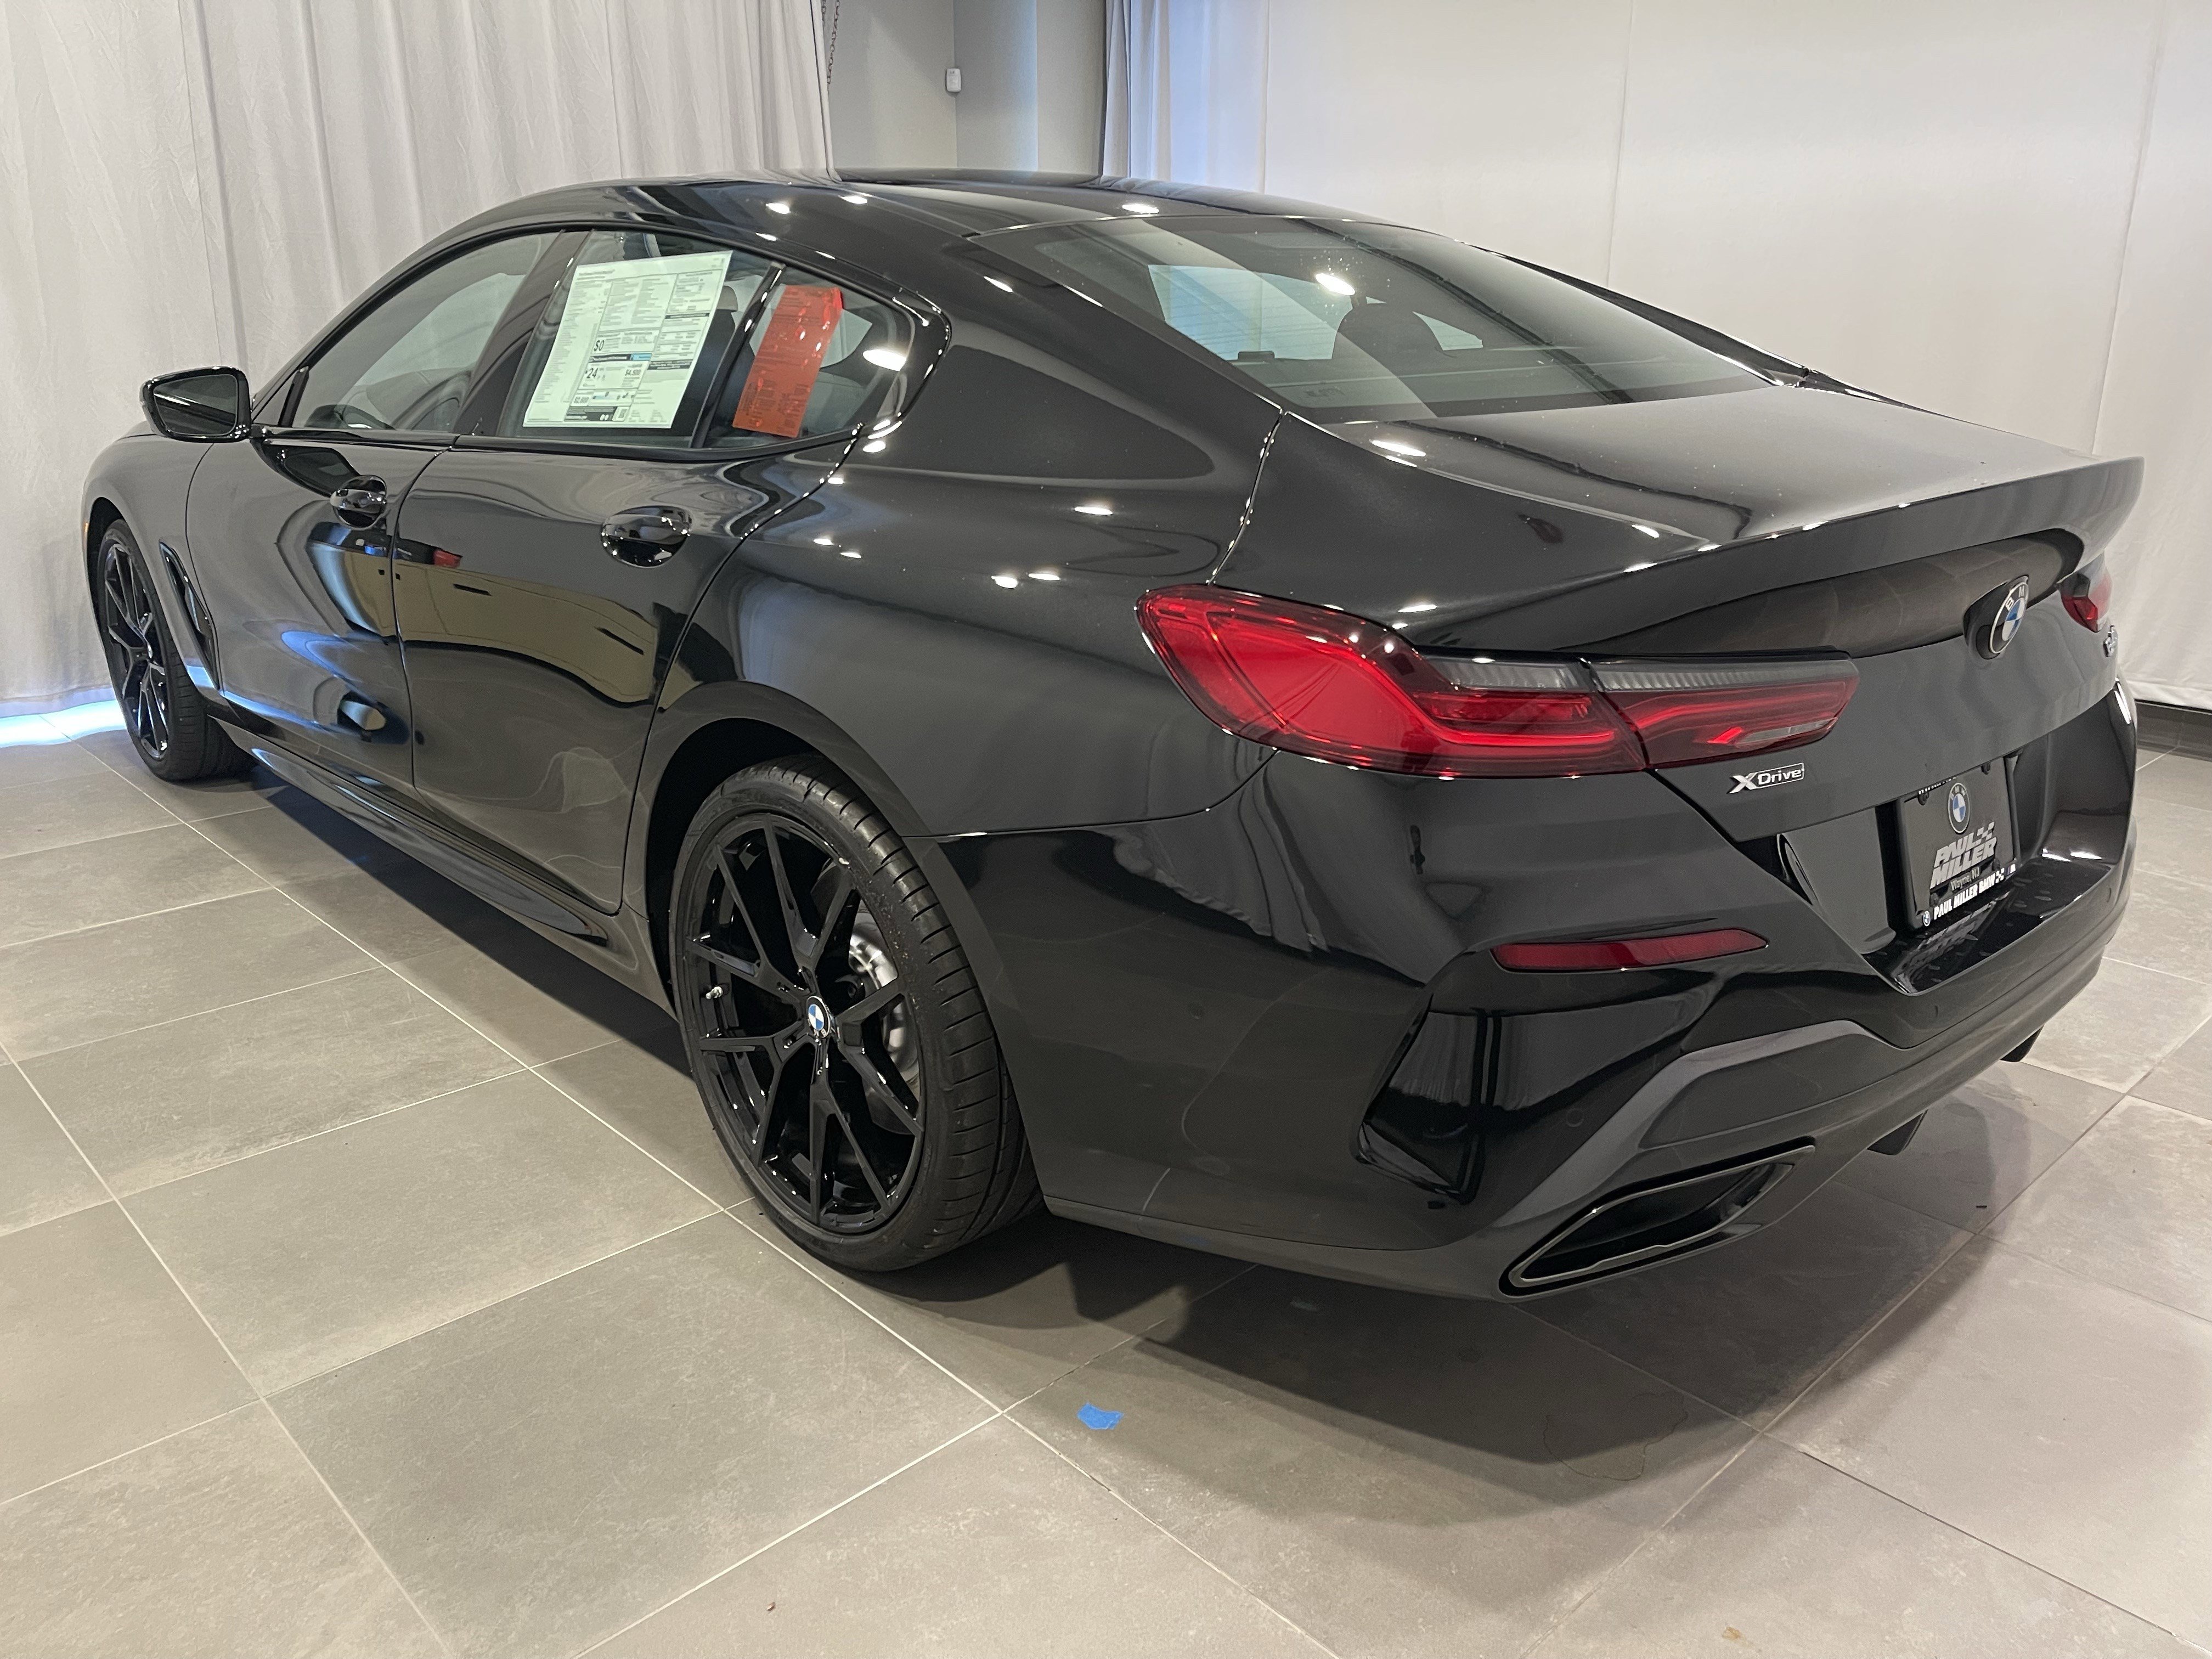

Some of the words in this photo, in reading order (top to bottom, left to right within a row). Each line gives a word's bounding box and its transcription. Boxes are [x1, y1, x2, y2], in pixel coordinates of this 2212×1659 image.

[1929, 837, 1997, 889] MILLER
[1934, 832, 1982, 868] PAUL
[1934, 899, 1953, 920] PAUL
[1954, 884, 1978, 909] MILLER
[1979, 873, 1995, 894] BMW
